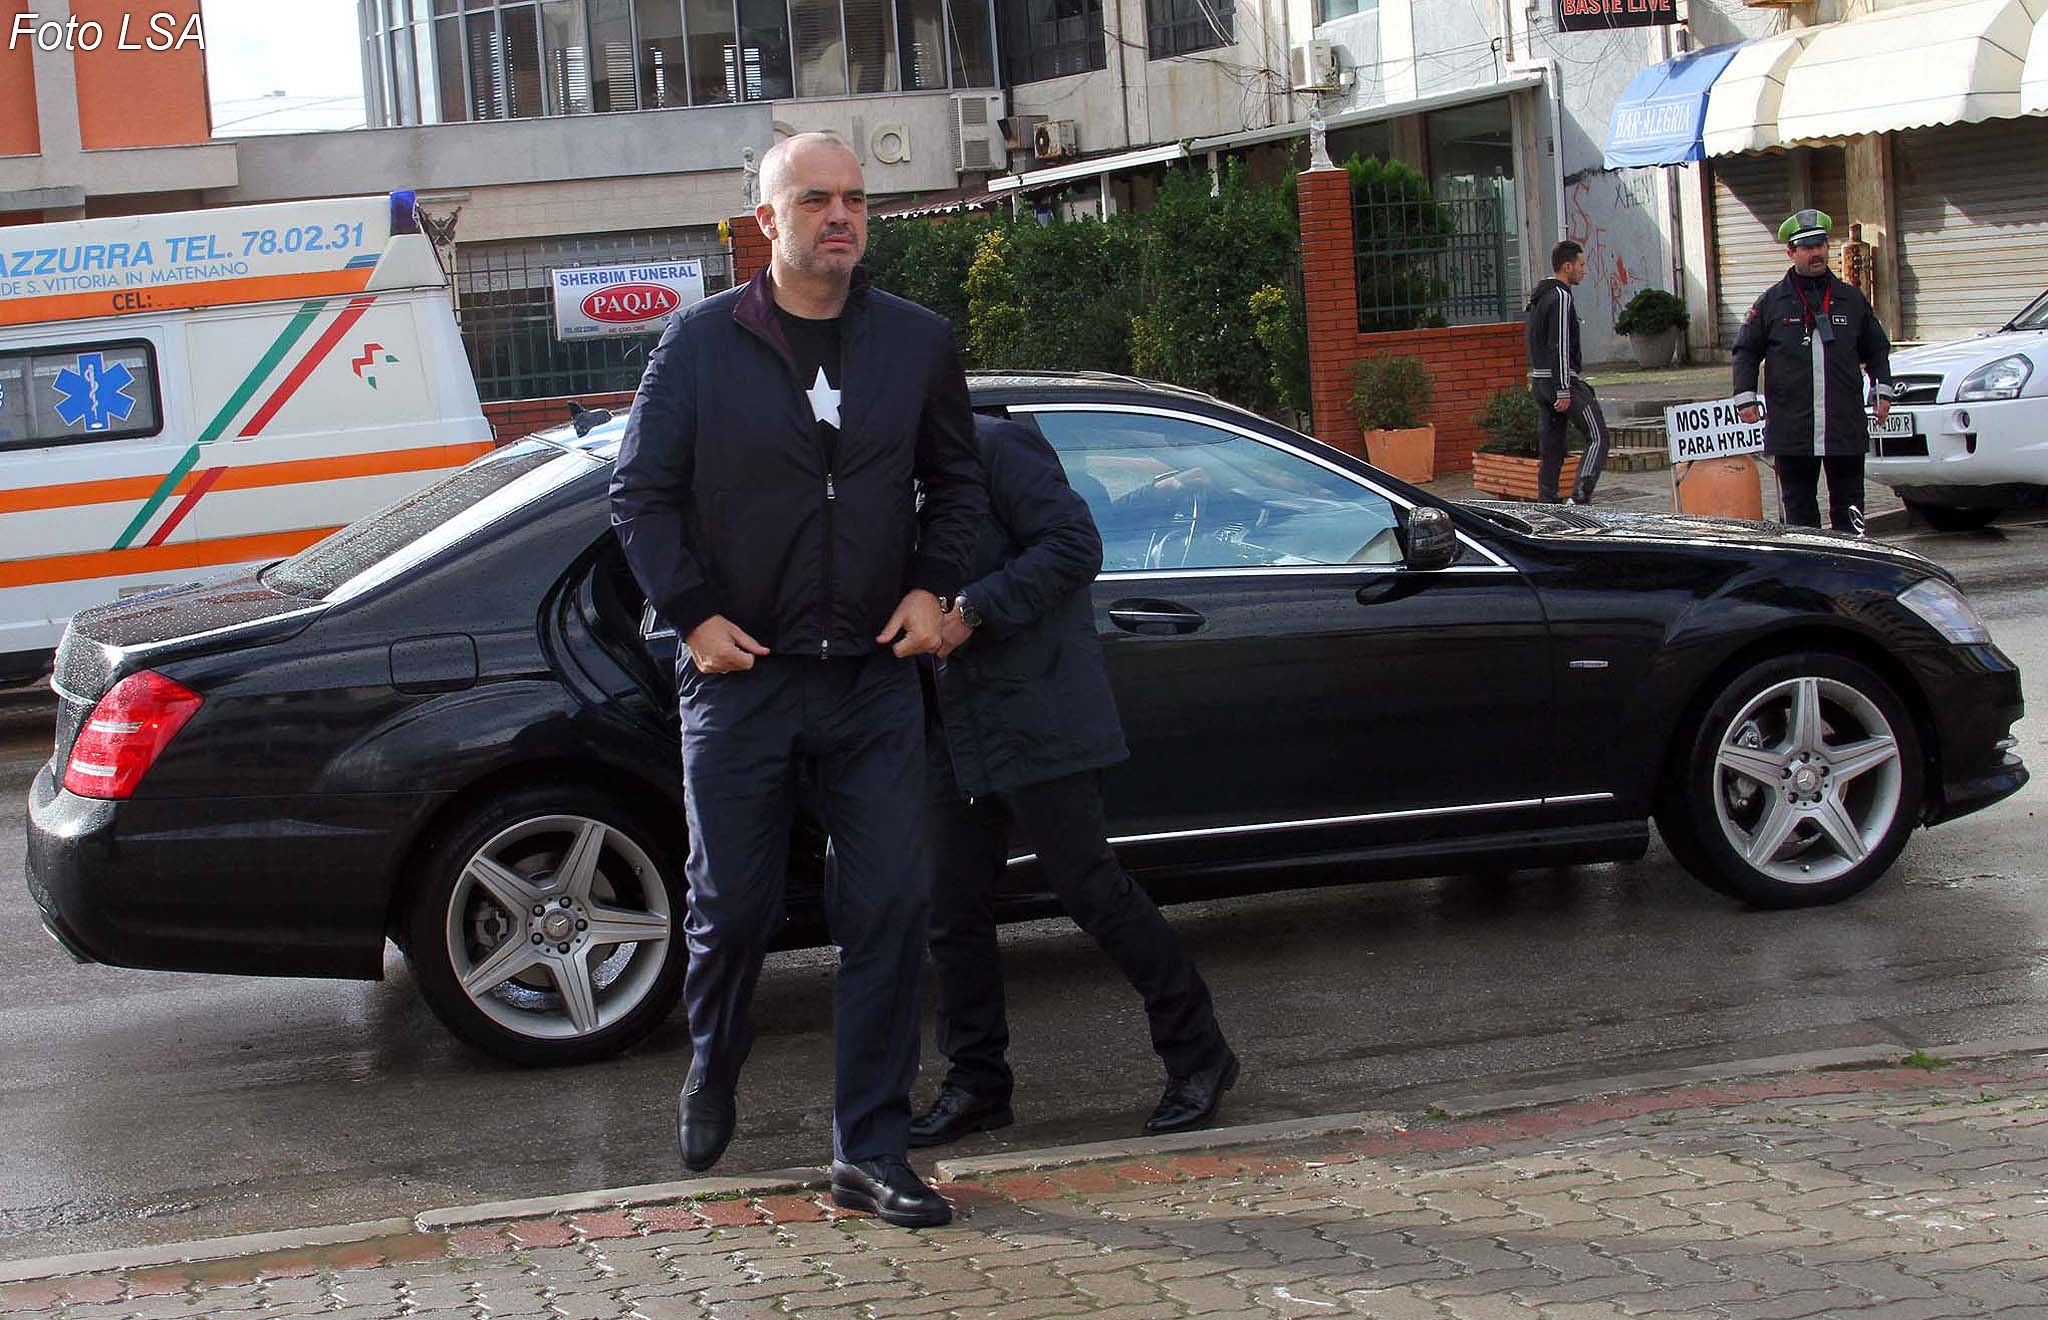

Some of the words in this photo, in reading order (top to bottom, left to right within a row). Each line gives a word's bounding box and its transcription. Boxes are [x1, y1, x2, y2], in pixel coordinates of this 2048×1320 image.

[165, 234, 233, 263] TEL.
[240, 221, 363, 257] 78.02.31
[27, 280, 40, 294] S.
[43, 273, 118, 292] VITTORIA
[125, 271, 143, 285] IN
[151, 262, 249, 283] MATENANO
[560, 270, 626, 287] SHERBIM
[629, 266, 697, 282] FUNERAL
[112, 292, 152, 311] CEL:
[592, 290, 671, 315] PAQJA
[1676, 408, 1709, 432] MOS
[1678, 435, 1715, 456] PARA
